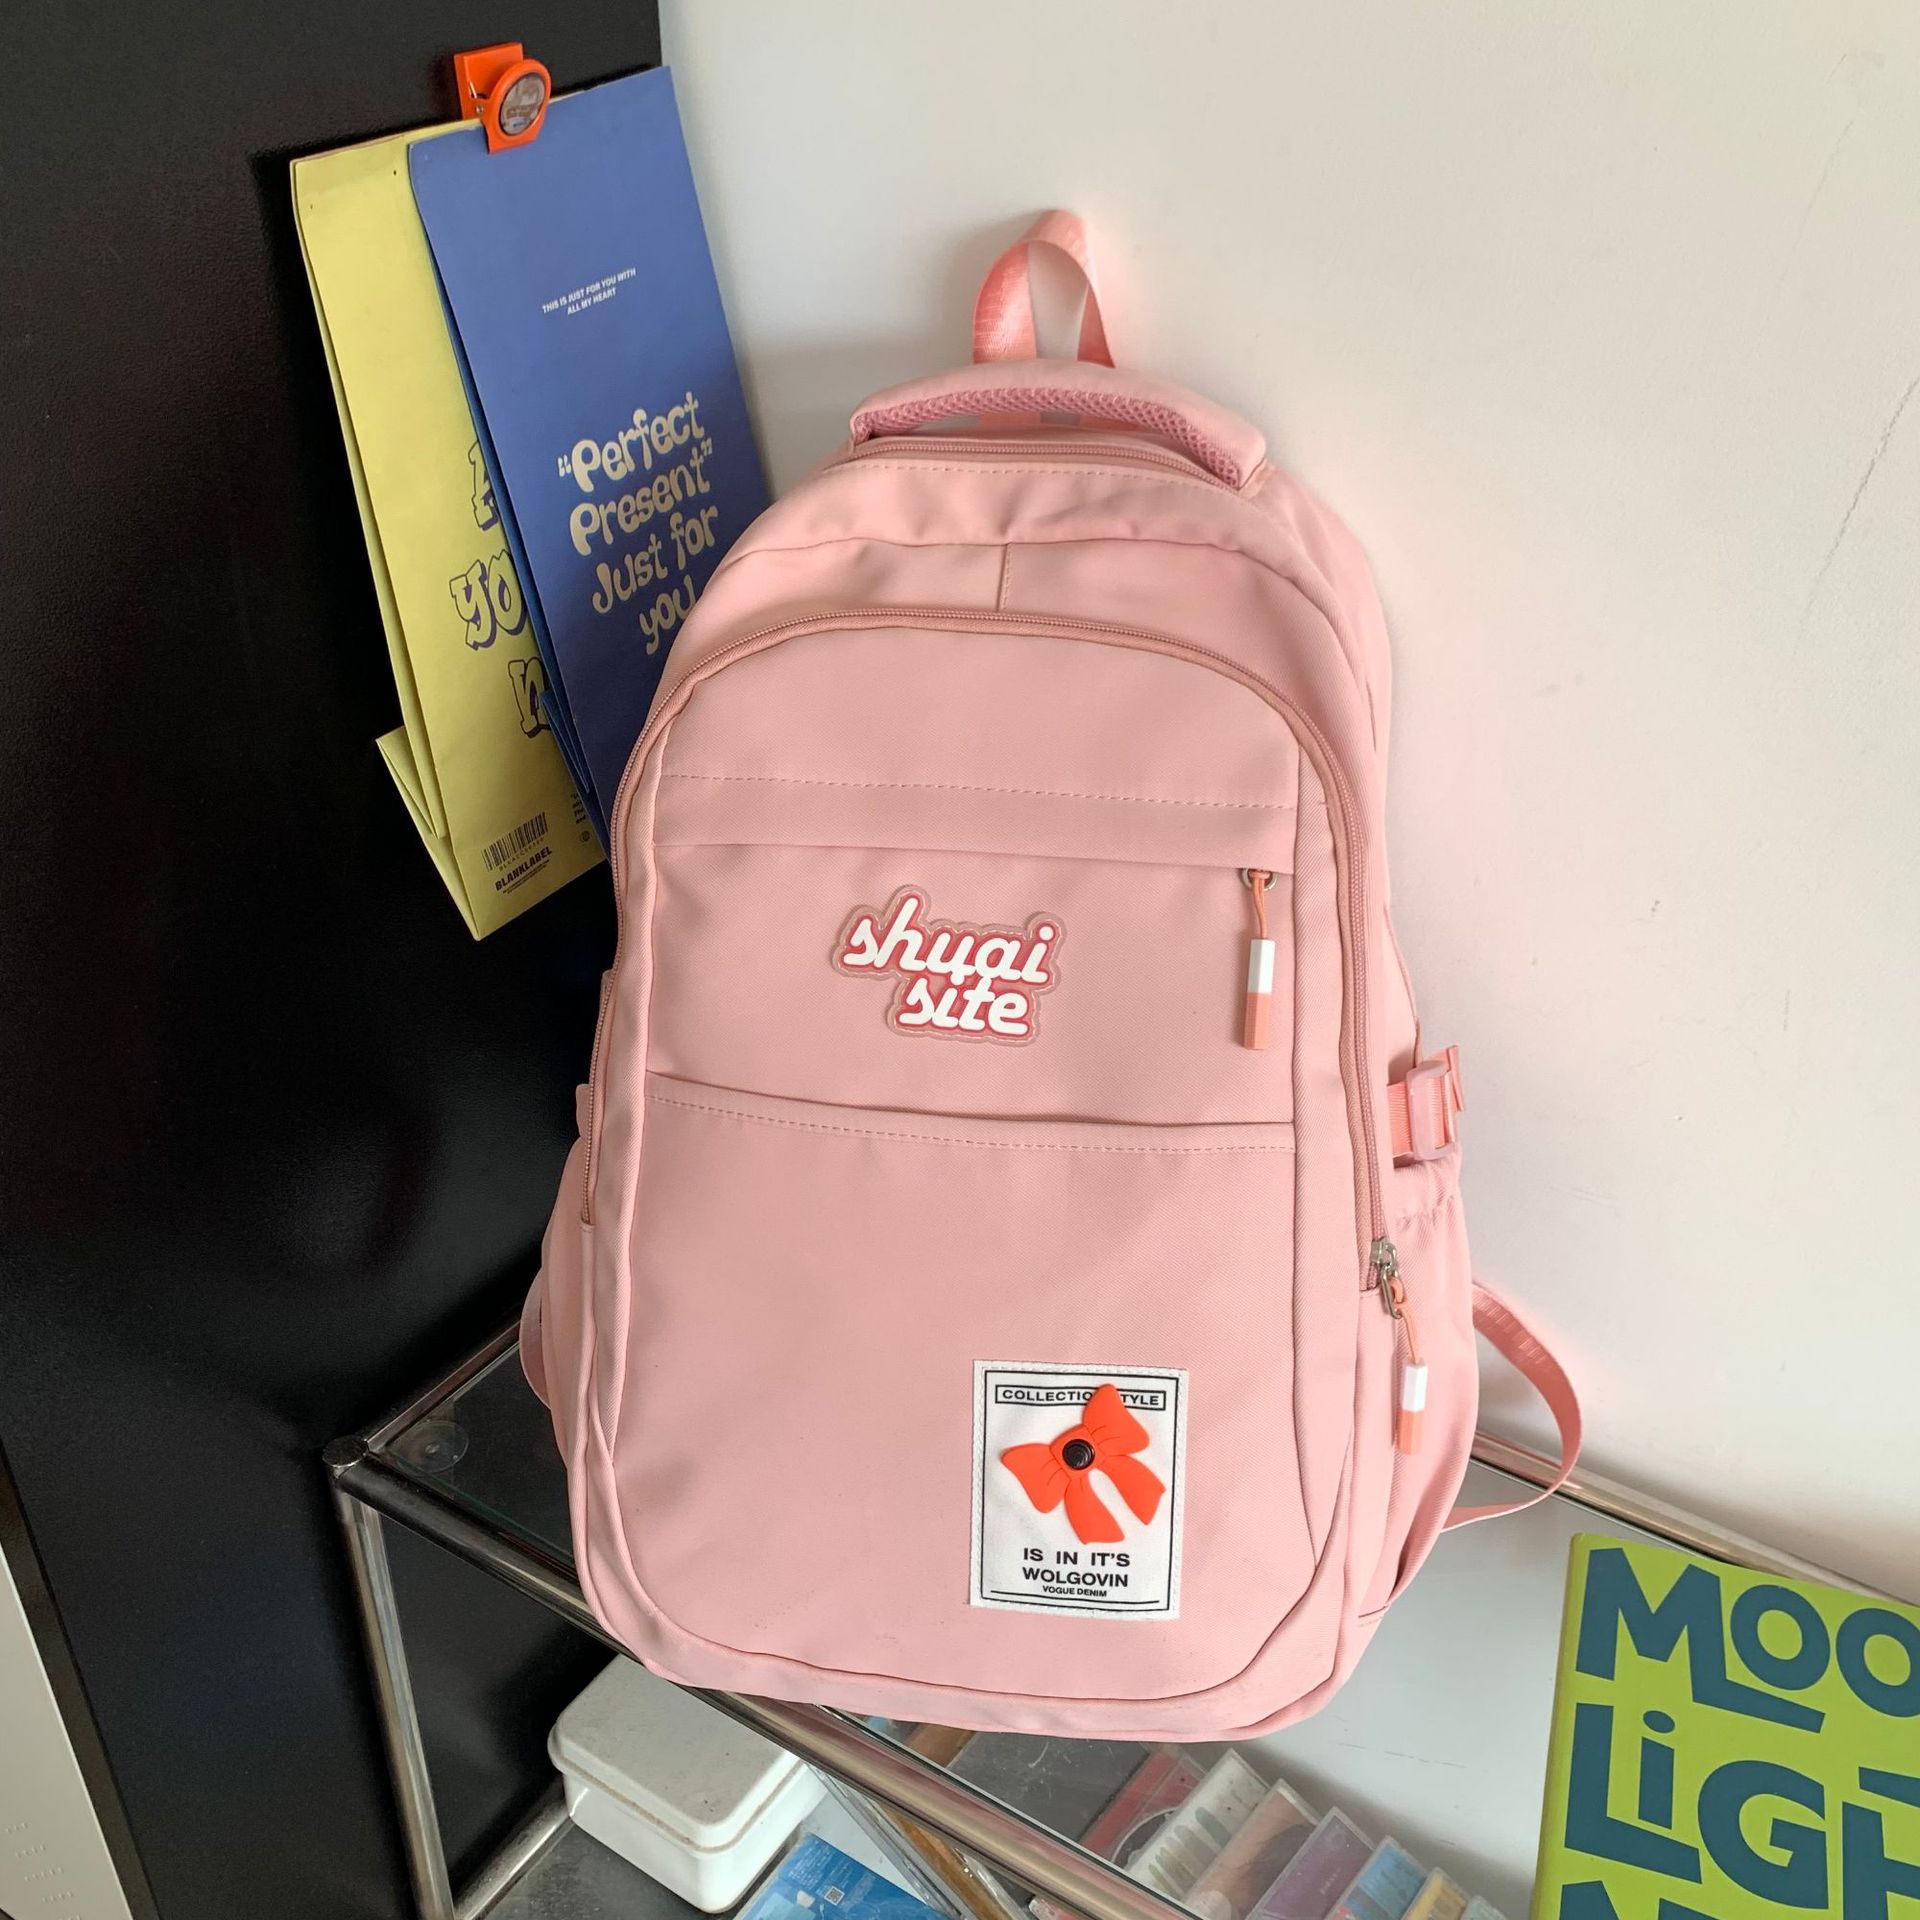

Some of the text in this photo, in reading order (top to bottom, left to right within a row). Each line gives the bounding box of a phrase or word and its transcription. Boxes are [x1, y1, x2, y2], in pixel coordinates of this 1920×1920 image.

[542, 267, 636, 314] THIS IS JUST FOR YOU WITH
[567, 287, 617, 315] ALL MY HEART
[669, 505, 719, 571] for
[639, 575, 700, 655] you
[495, 846, 553, 891] BLANKLABEL
[843, 897, 1054, 983] shuai
[899, 969, 1029, 1035] site
[1002, 1389, 1159, 1406] COLLECTIO TYLE
[1022, 1566, 1129, 1588] WOLGOVIN
[1023, 1547, 1130, 1567] IS IN IT'S
[1042, 1585, 1108, 1598] VOGUE DENIM
